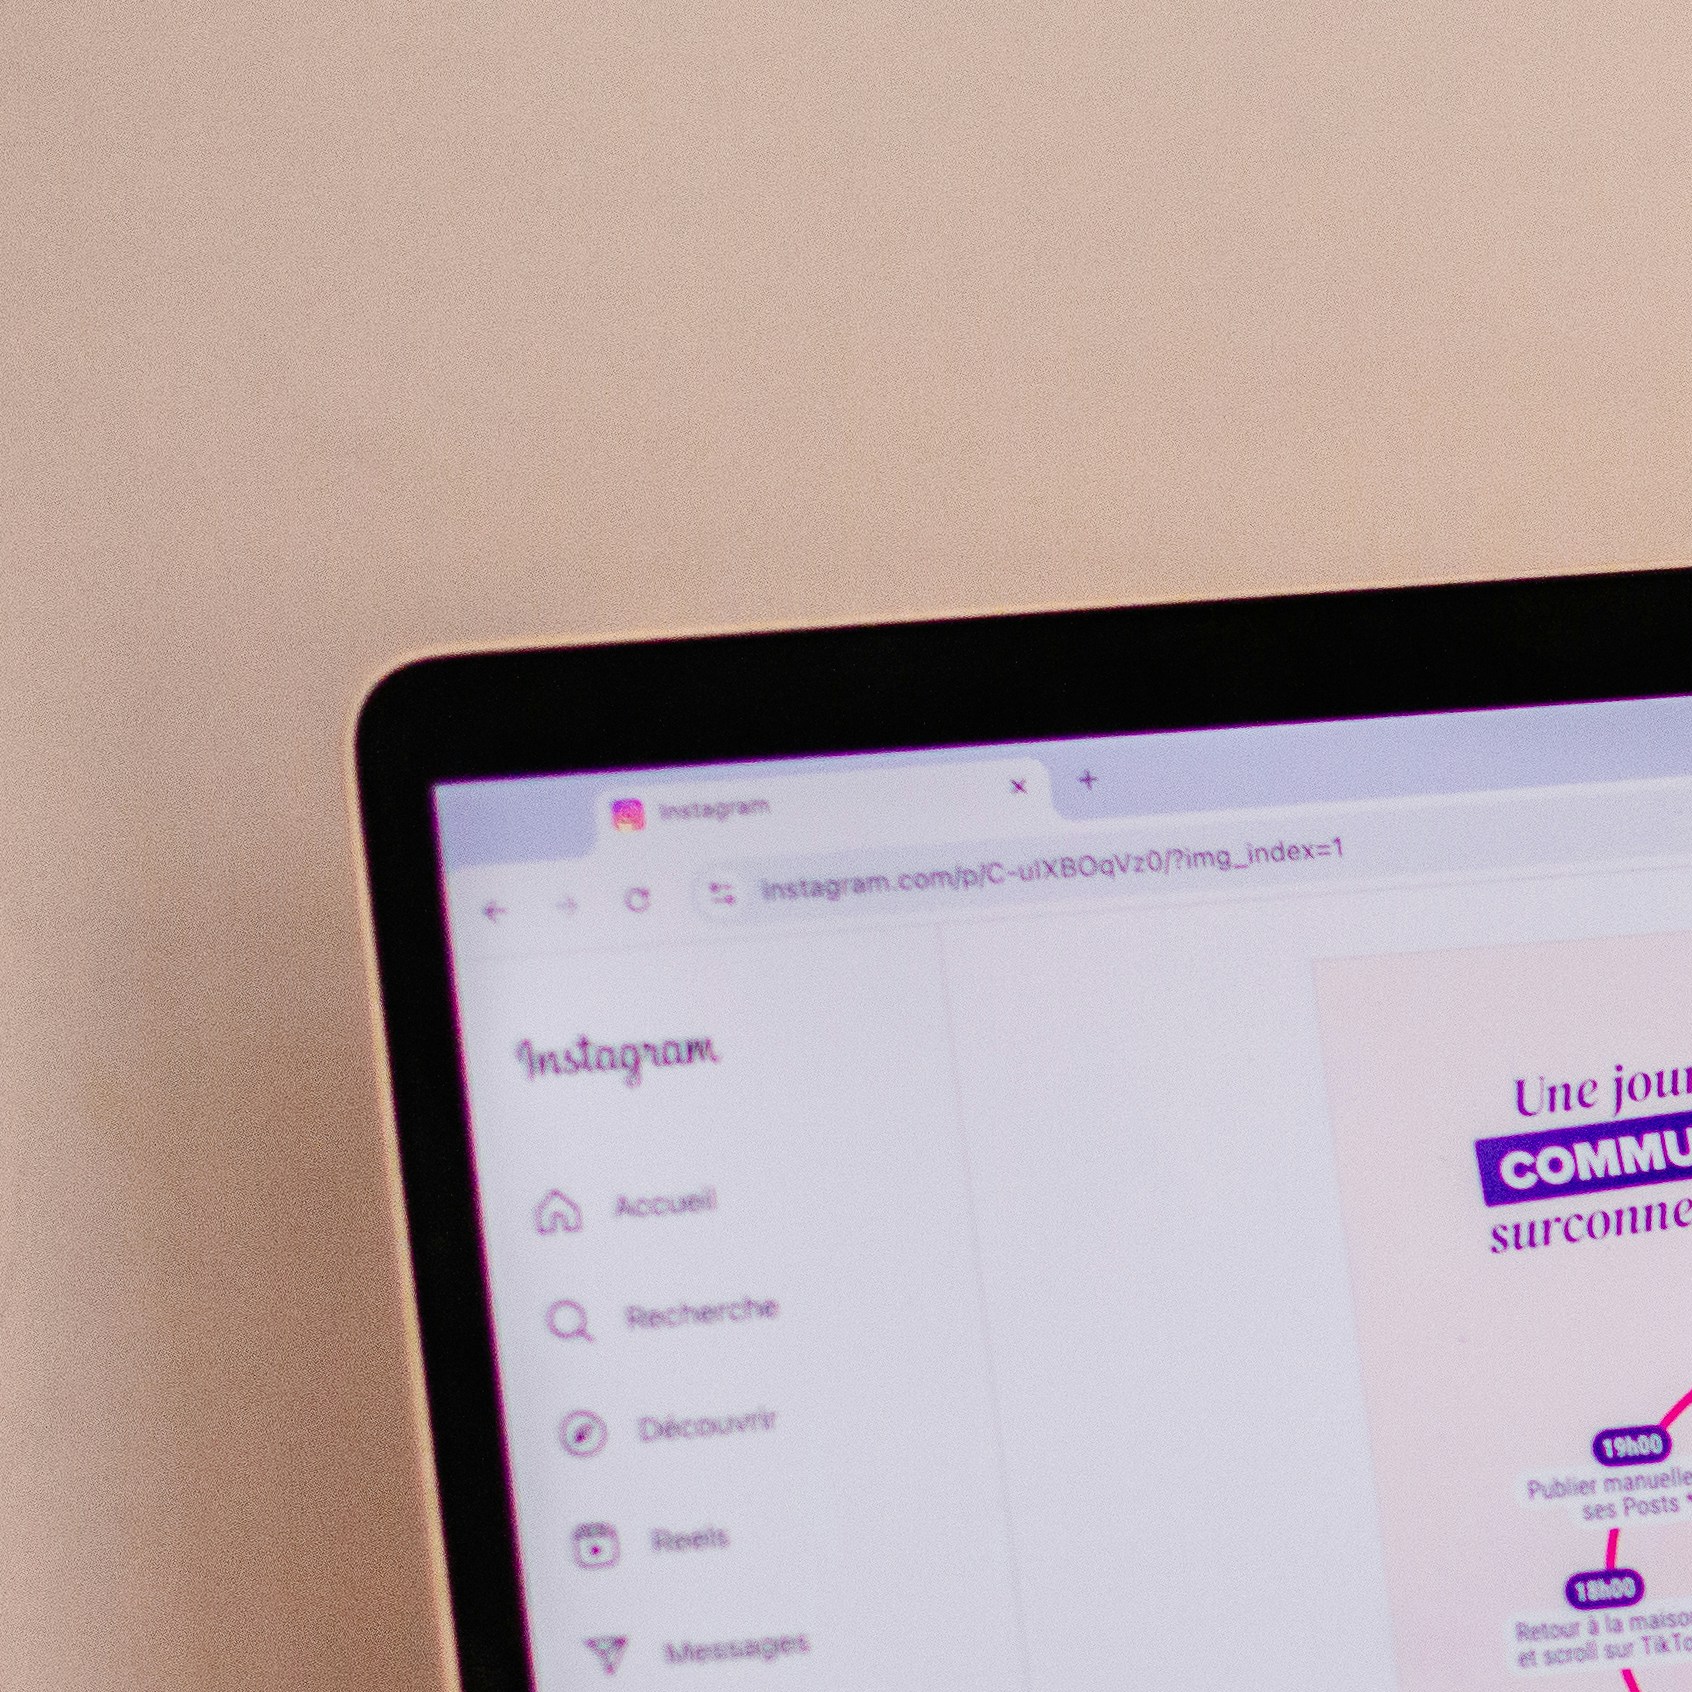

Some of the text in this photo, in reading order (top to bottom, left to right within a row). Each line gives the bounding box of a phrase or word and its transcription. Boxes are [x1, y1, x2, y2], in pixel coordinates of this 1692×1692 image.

[658, 798, 771, 824] Instagram
[515, 1034, 720, 1088] Instagram
[1515, 1078, 1599, 1118] Une
[614, 1189, 717, 1219] Accueil
[625, 1297, 780, 1330] Recherche
[637, 1410, 778, 1444] Découvrir
[1526, 1478, 1598, 1501] Publier
[1581, 1494, 1682, 1523] ses Posts
[650, 1526, 730, 1553] Reels
[1514, 1620, 1582, 1643] Retour
[1587, 1615, 1601, 1638] à
[1604, 1614, 1625, 1635] la
[663, 1633, 811, 1665] Messages
[1516, 1649, 1537, 1669] et
[1542, 1640, 1598, 1667] scroll
[1603, 1641, 1635, 1661] sur
